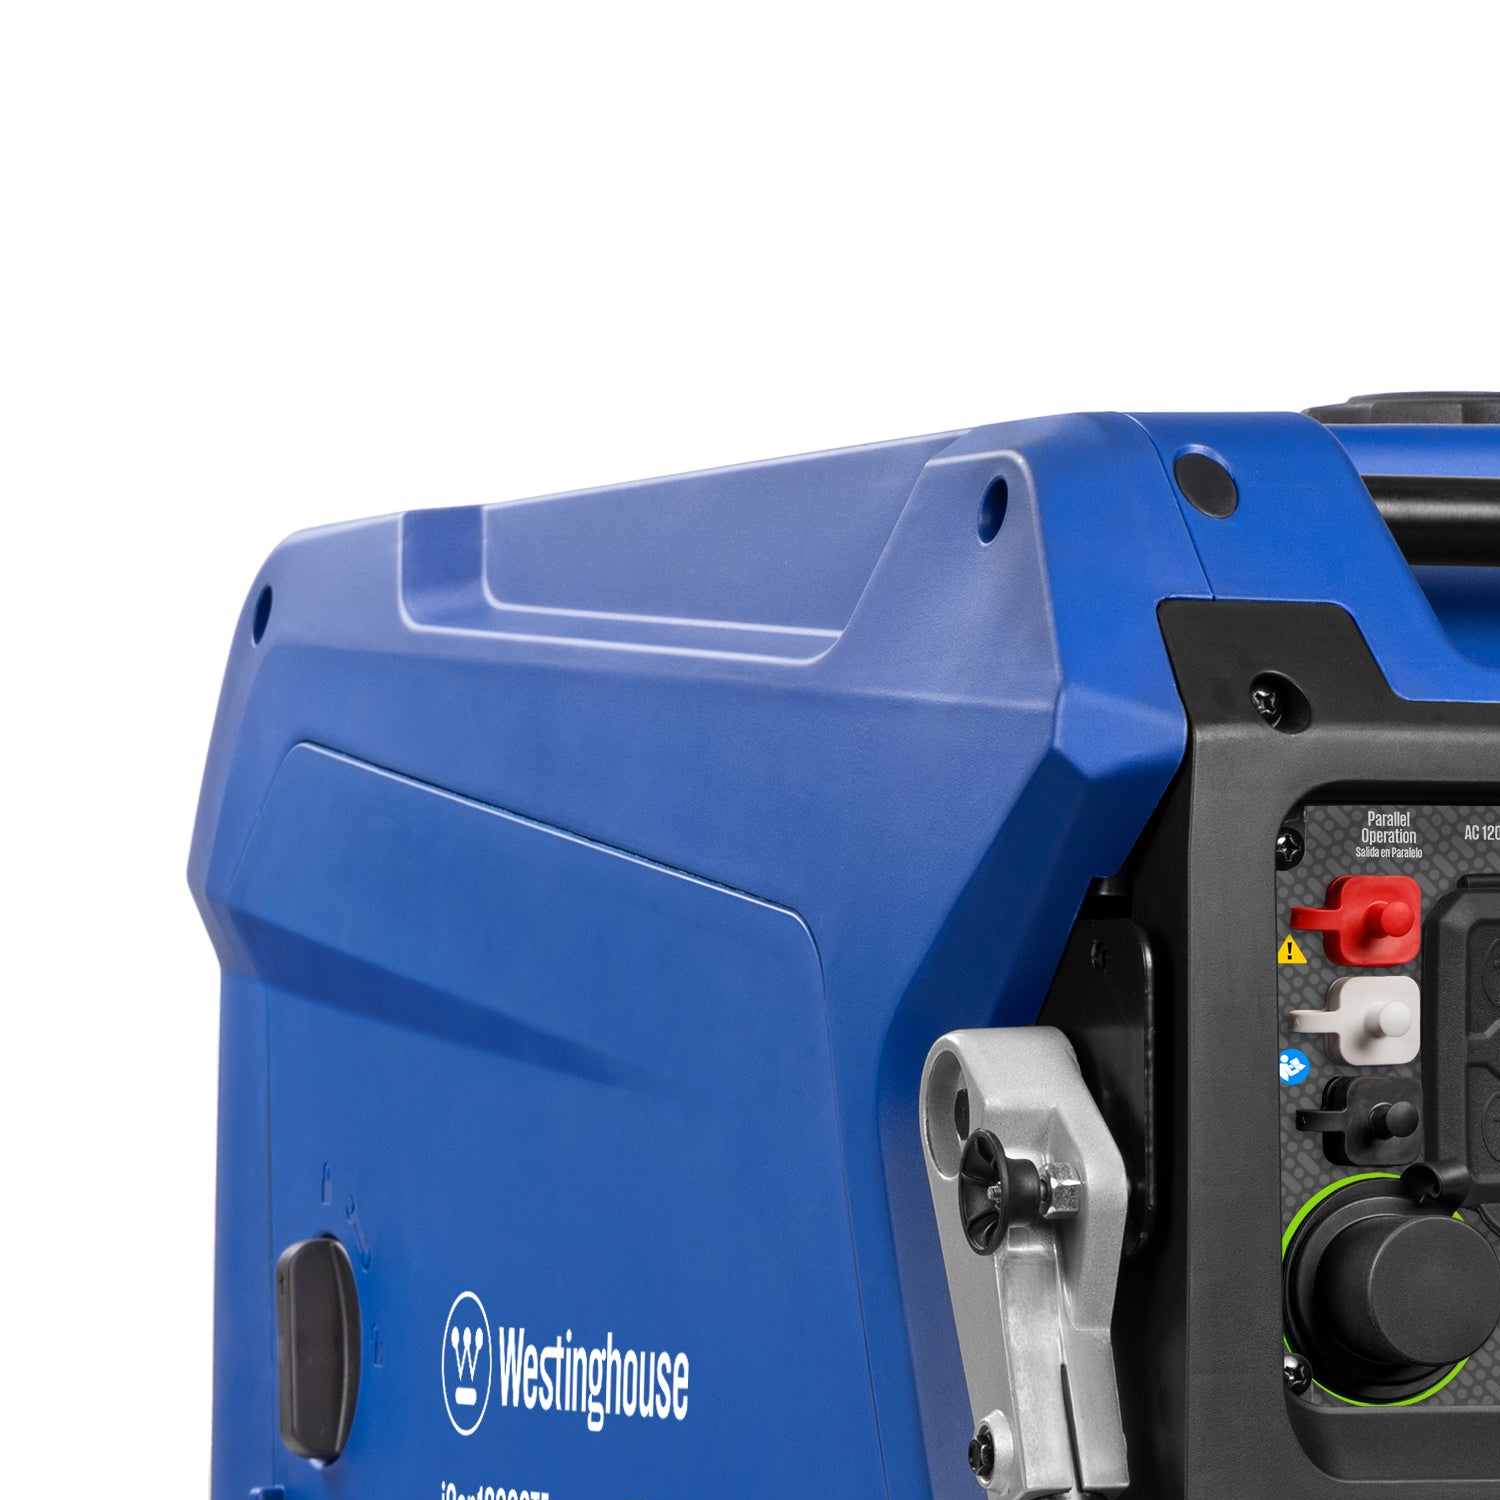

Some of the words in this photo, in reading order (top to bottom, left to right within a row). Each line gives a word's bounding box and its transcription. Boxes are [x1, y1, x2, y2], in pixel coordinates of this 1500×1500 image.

[1368, 811, 1410, 827] Parallel
[1362, 828, 1416, 845] Operation
[1464, 825, 1479, 840] AC
[1356, 847, 1379, 858] Salida
[1381, 849, 1390, 858] en
[1392, 847, 1422, 858] Paralelo
[499, 1326, 689, 1431] Westinghouse
